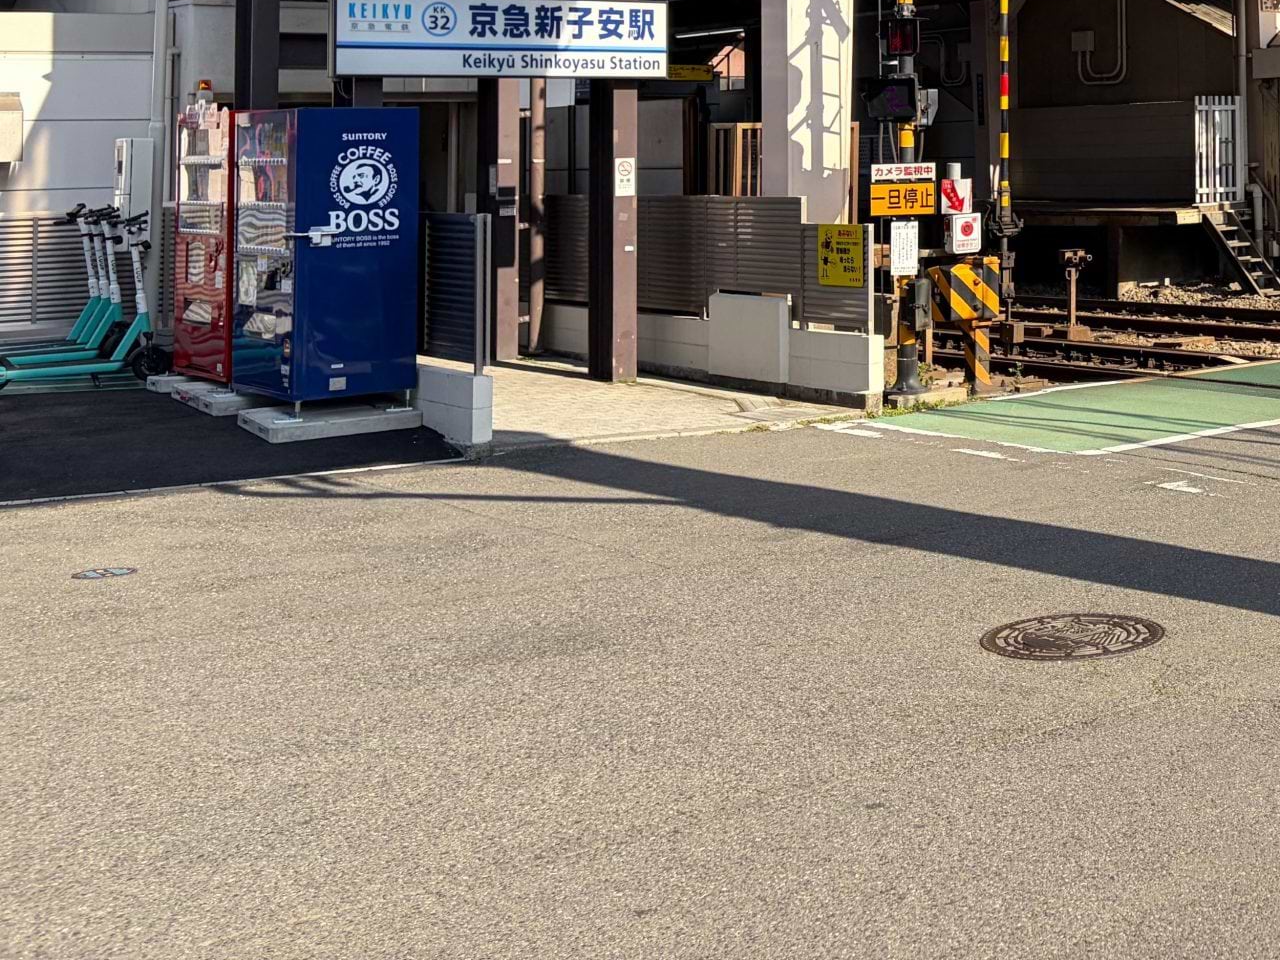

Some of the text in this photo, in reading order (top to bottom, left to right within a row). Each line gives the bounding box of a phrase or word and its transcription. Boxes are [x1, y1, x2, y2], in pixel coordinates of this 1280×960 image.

[348, 2, 412, 20] KEIKYU
[433, 6, 447, 14] KK
[428, 15, 451, 31] 32
[468, 3, 655, 41] 京急新子安駅
[462, 53, 660, 73] Keikyū Shinkoyasu Station
[342, 132, 387, 141] SUNTORY
[337, 145, 392, 165] COFFEE
[874, 166, 933, 177] カメラ監視中
[871, 188, 934, 209] 一旦停止
[328, 208, 400, 233] BOSS
